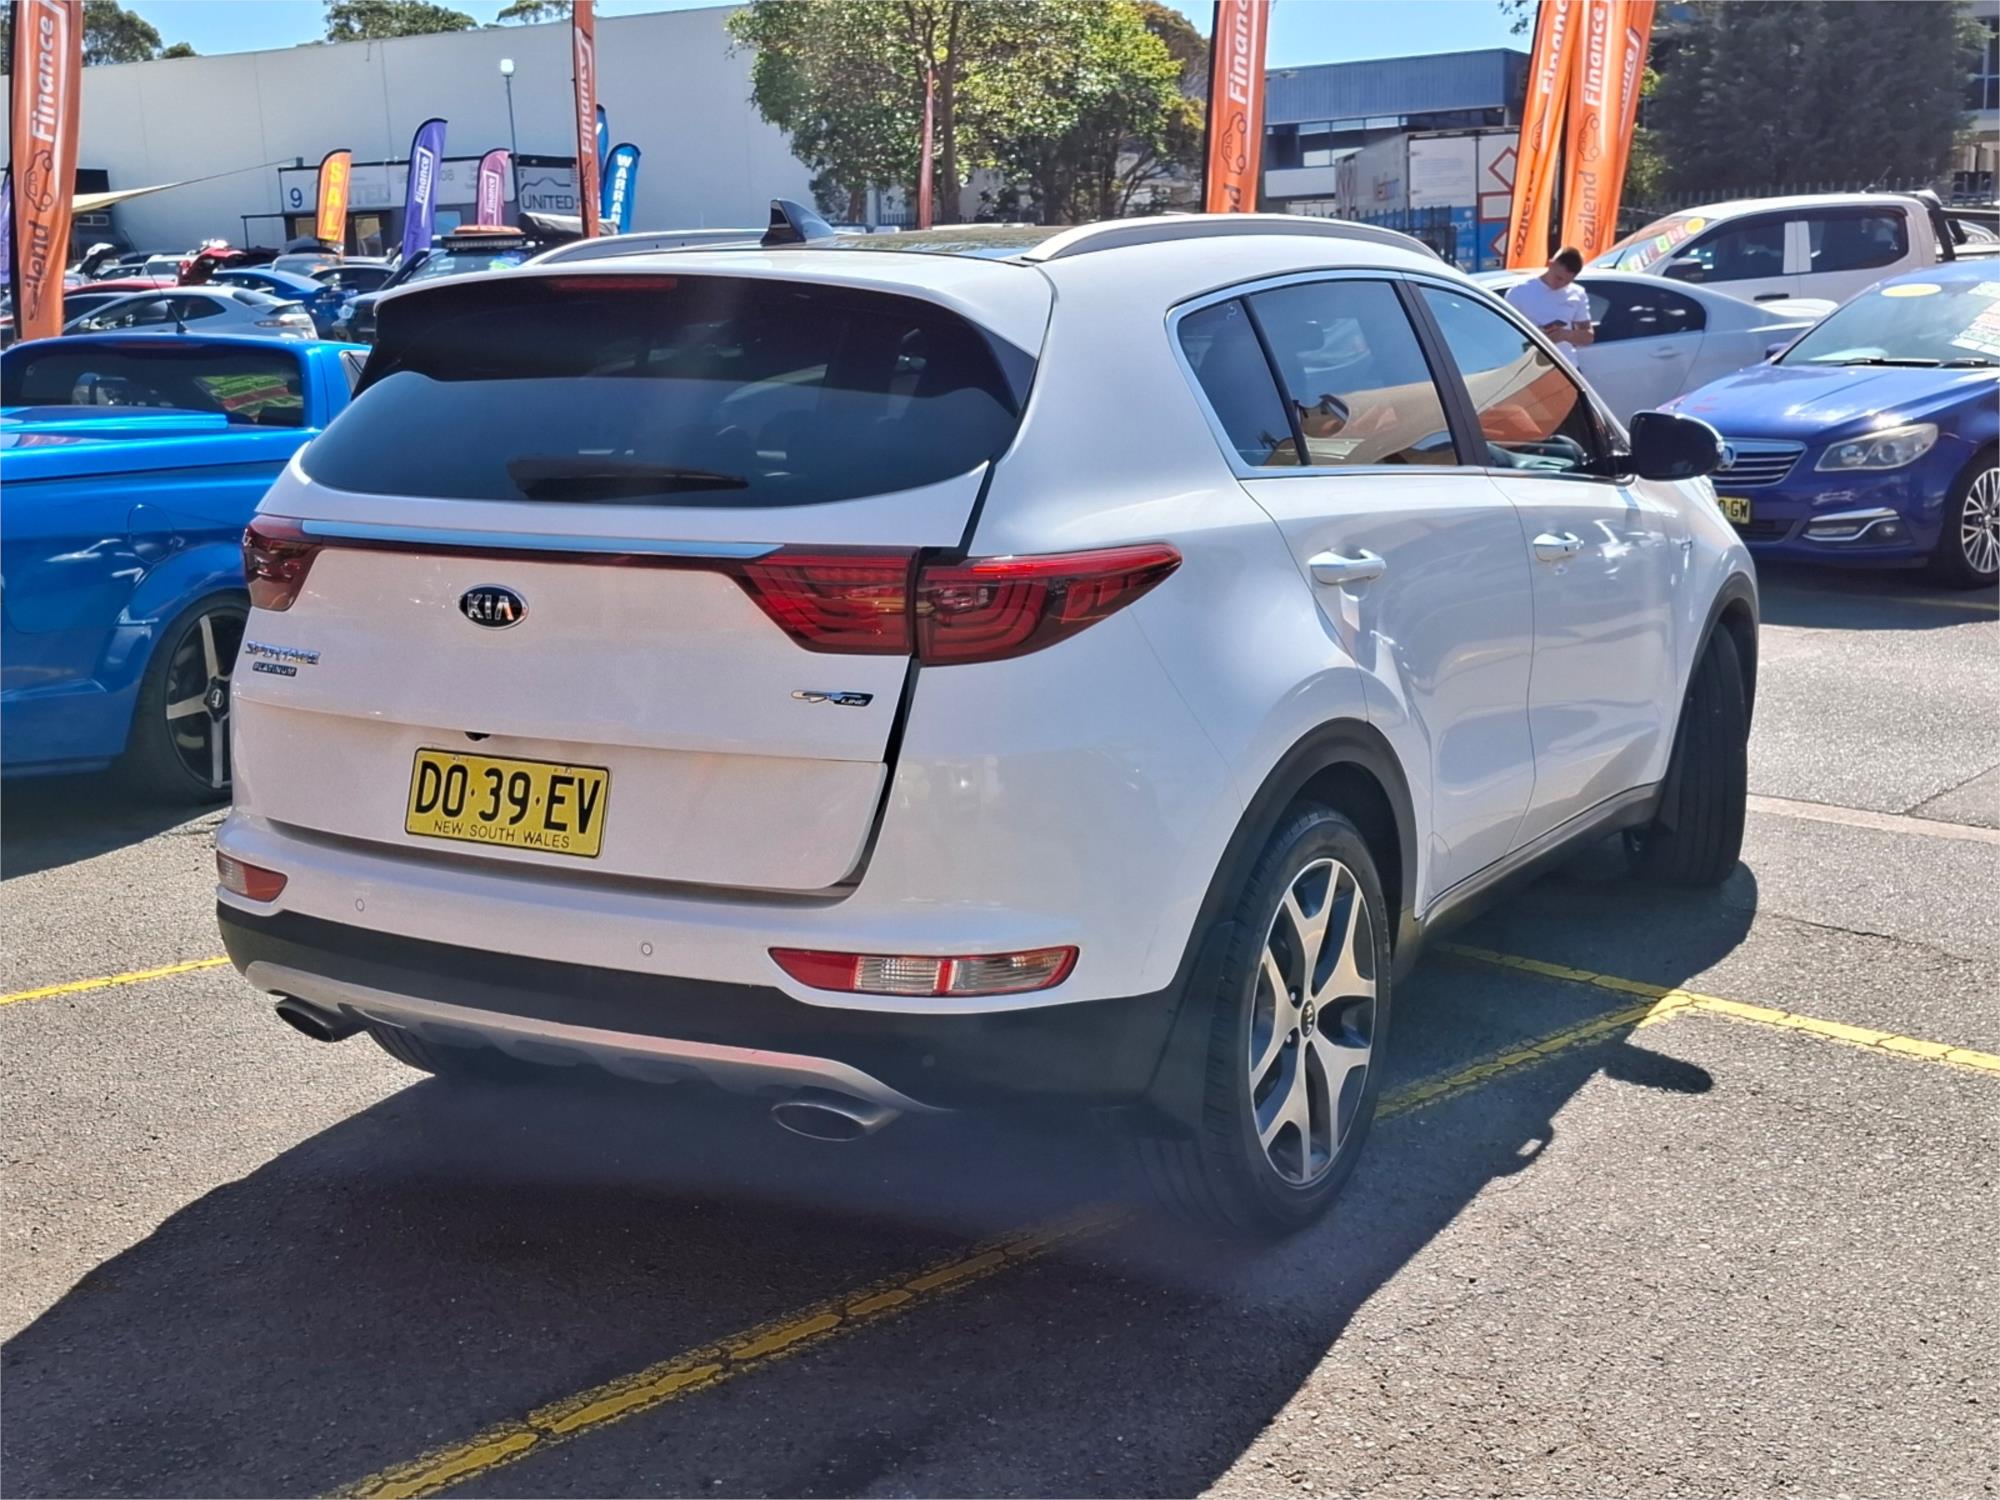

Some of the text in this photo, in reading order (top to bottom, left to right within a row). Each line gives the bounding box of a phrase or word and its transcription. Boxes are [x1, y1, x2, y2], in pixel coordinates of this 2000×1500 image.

[1584, 7, 1604, 107] Finance
[32, 15, 54, 142] Finance
[289, 187, 304, 209] 9
[521, 194, 575, 210] UNITED
[1578, 170, 1598, 250] ezilend
[466, 593, 515, 621] KIA
[433, 820, 570, 849] NEW SOUTH WALES
